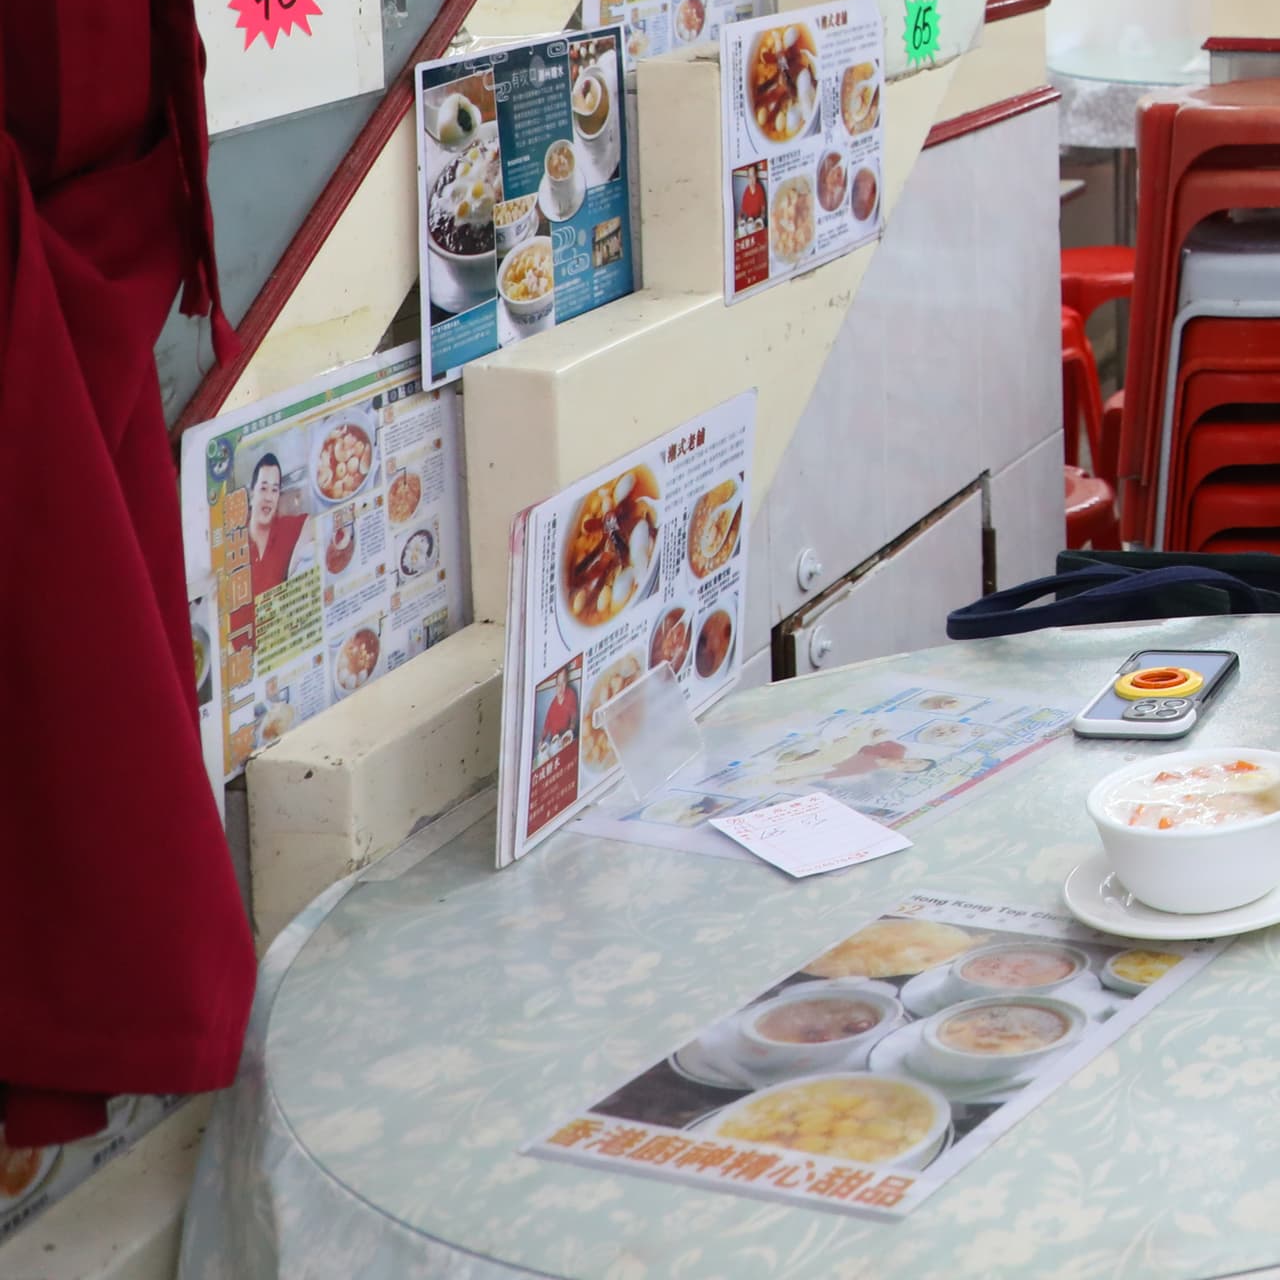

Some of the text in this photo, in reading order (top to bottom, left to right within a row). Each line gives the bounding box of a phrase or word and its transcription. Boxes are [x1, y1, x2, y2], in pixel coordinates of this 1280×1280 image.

[912, 5, 933, 51] 65
[953, 900, 993, 913] Kong
[999, 906, 1027, 918] Top
[546, 1118, 916, 1208] 香港廚神精心甜品
